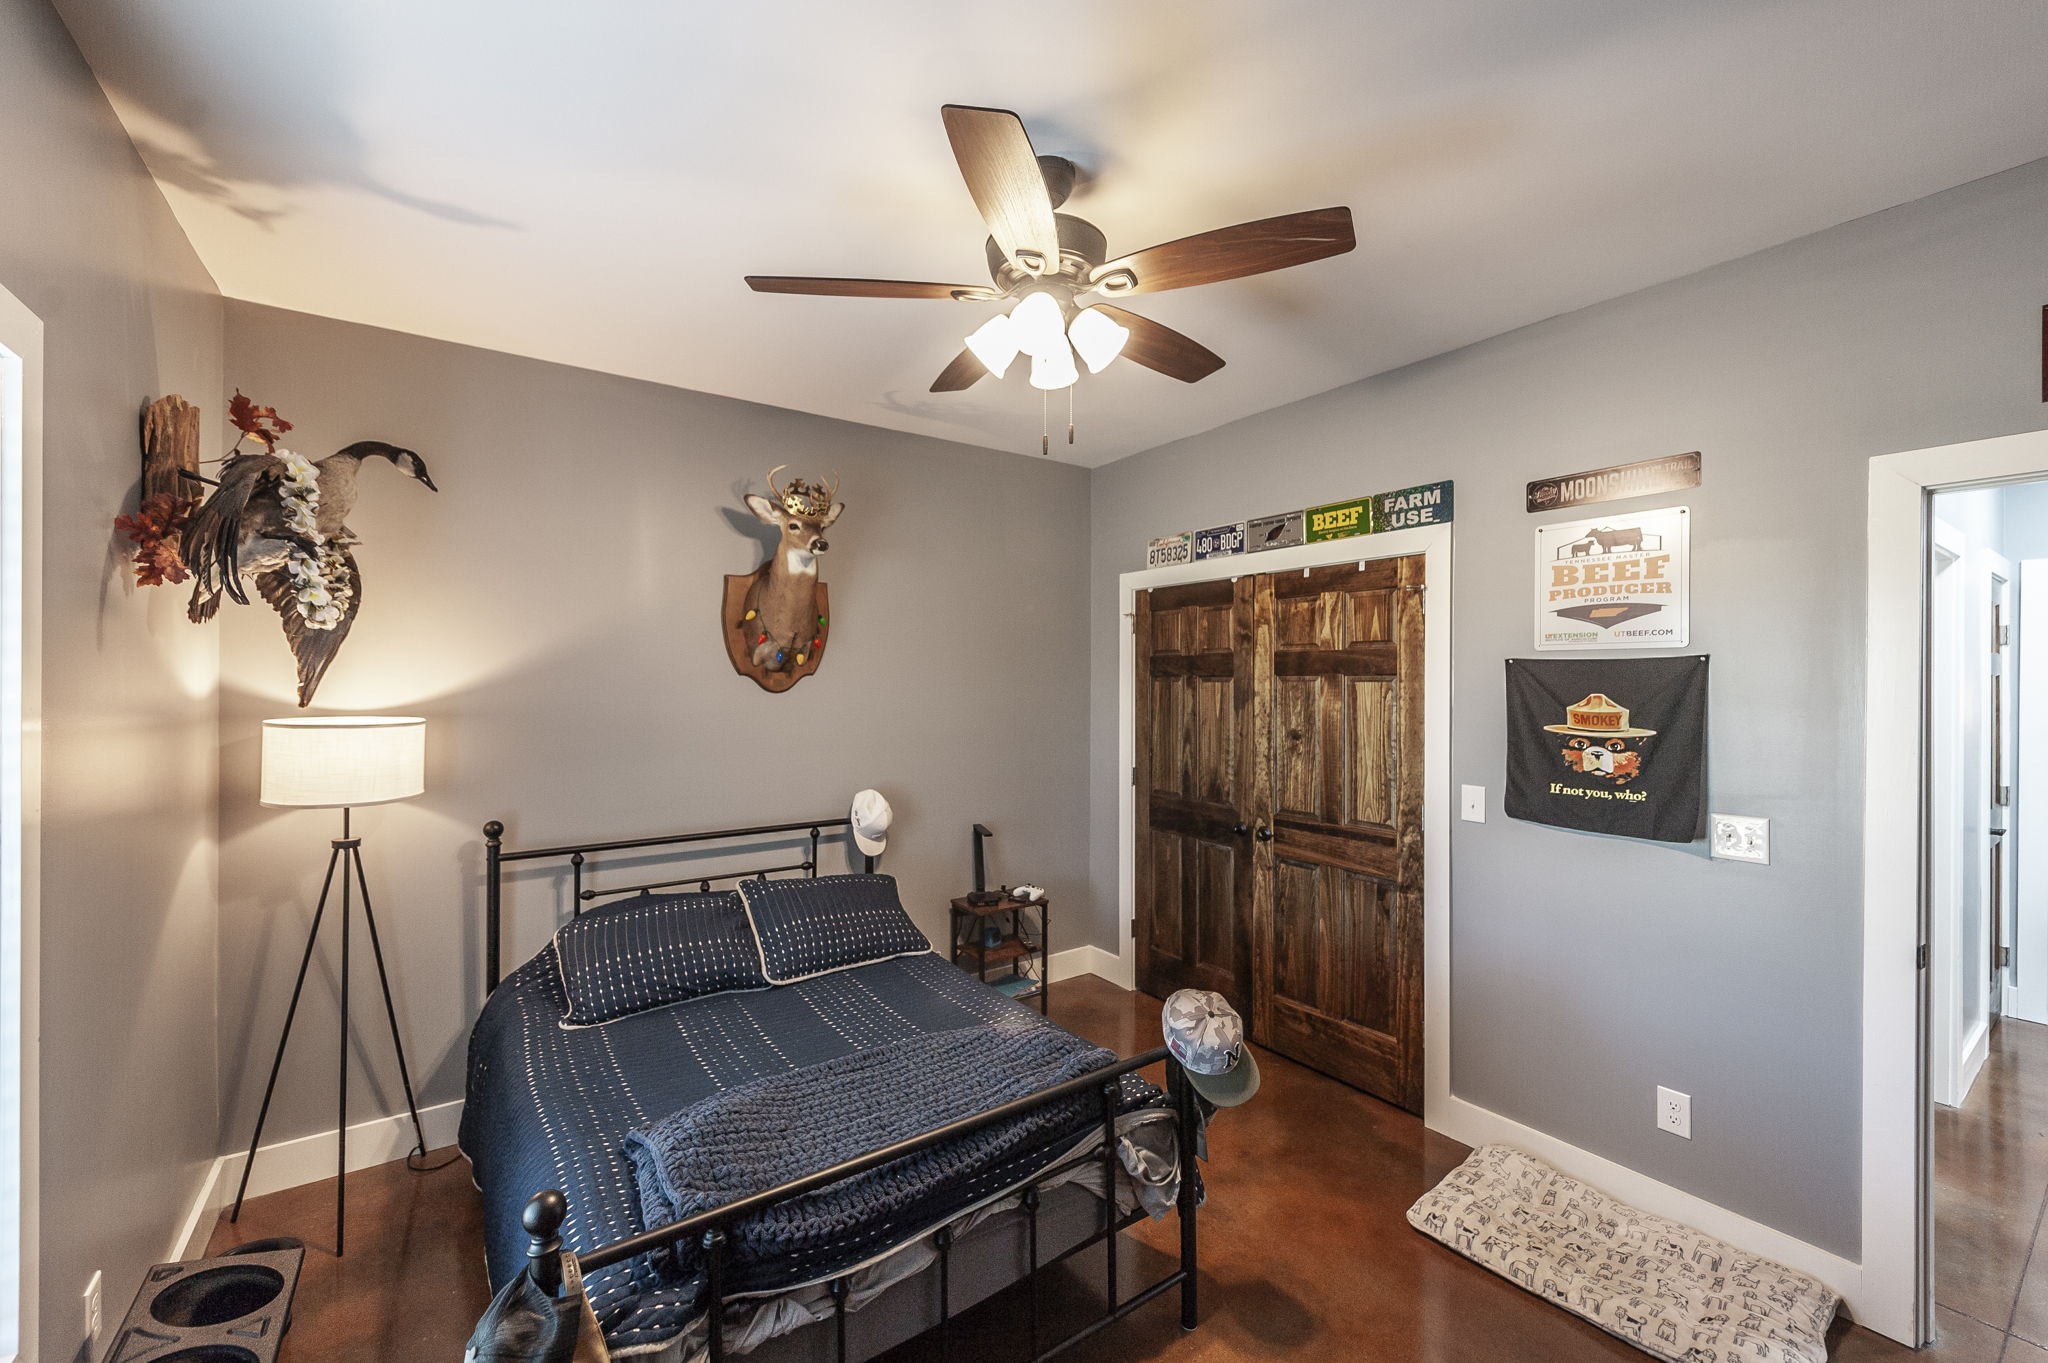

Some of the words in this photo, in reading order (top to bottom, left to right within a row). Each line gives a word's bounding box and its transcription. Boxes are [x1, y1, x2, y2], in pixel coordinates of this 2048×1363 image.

[1384, 489, 1441, 513] FARM
[1312, 506, 1363, 531] BEEF
[1391, 507, 1433, 528] USE
[1196, 537, 1212, 553] 480
[1565, 556, 1612, 564] TENNESSEE
[1551, 554, 1670, 587] BEEF
[1548, 582, 1672, 602] PRODUCER
[1614, 629, 1673, 637] UTBEEF.COM
[1573, 712, 1622, 727] SMOKEY
[1549, 783, 1563, 794] If
[1562, 787, 1584, 796] not
[1585, 789, 1613, 800] you,
[1614, 789, 1647, 801] who?
